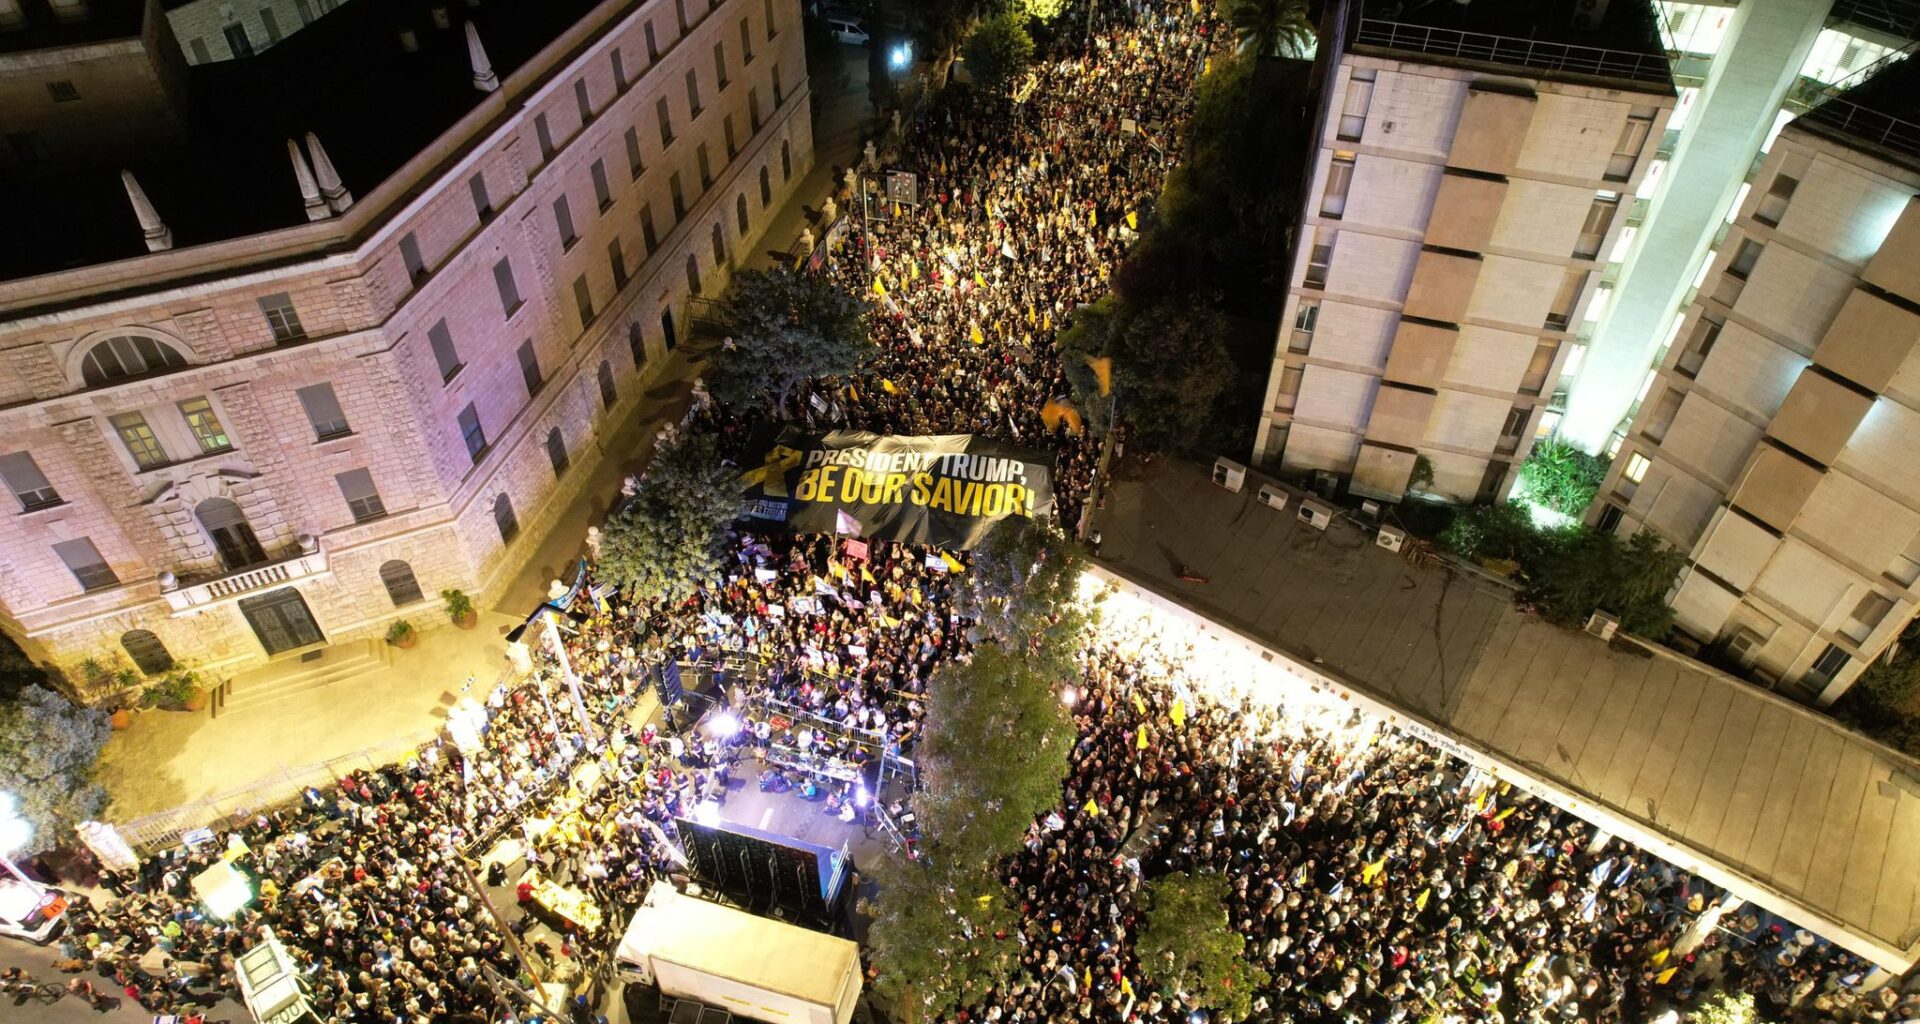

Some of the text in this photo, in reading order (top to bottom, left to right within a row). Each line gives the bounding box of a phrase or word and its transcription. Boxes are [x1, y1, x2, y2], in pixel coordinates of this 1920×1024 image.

[806, 448, 1027, 486] PRESIDENT TRUMP,
[795, 465, 1035, 519] BE OUR SAVIOR!
